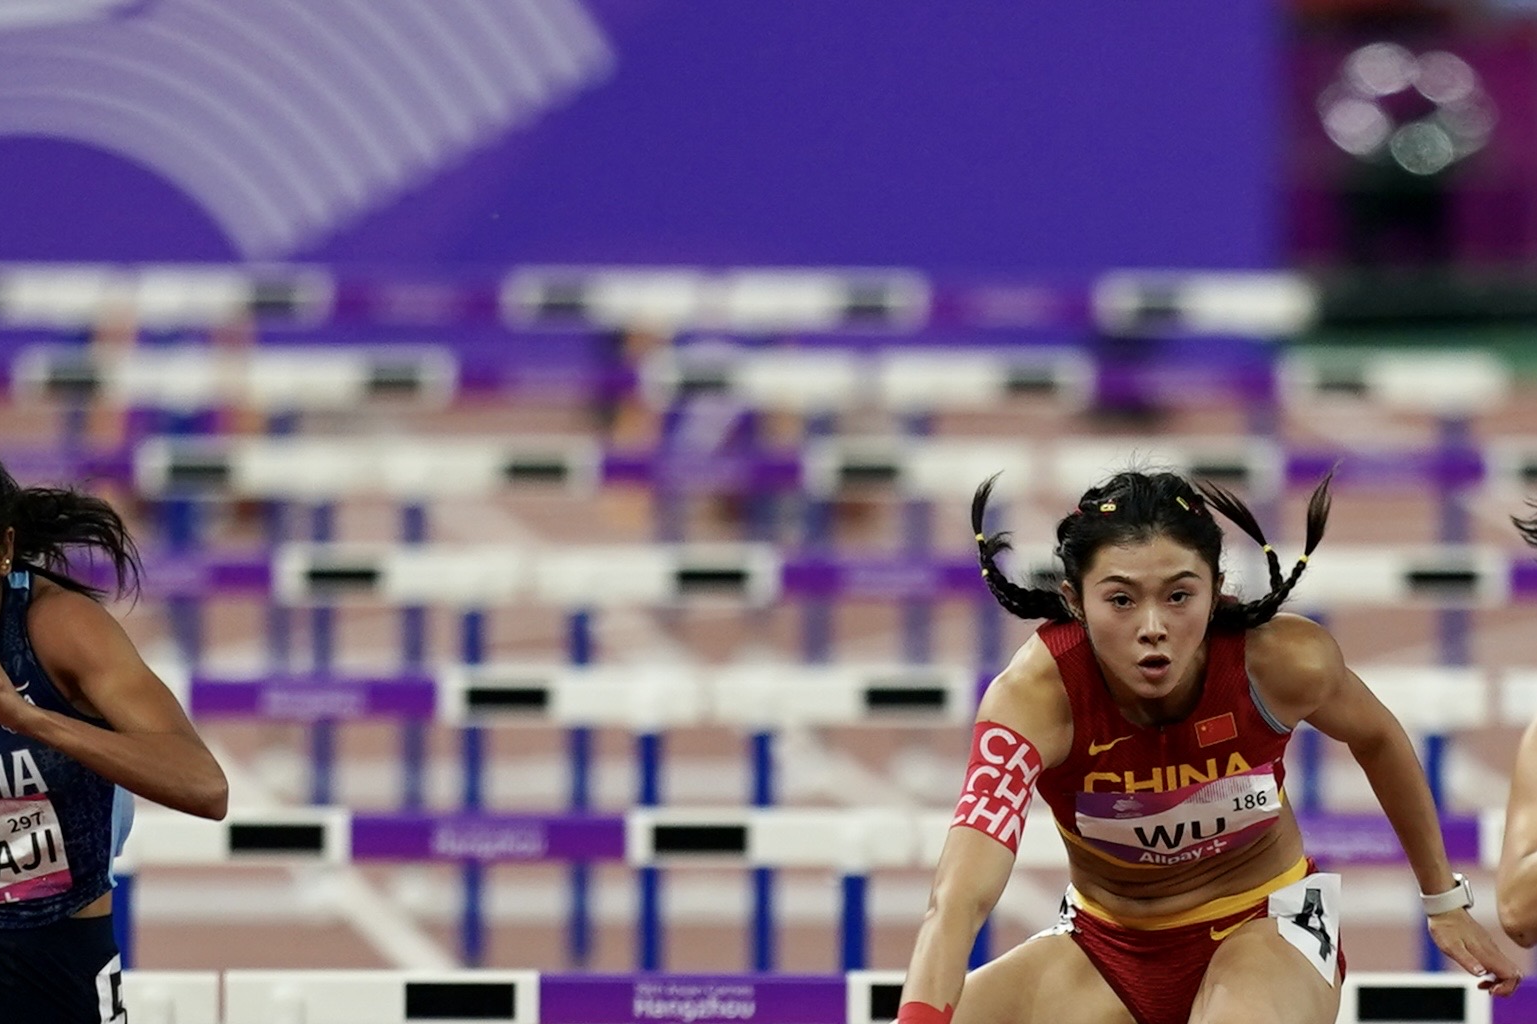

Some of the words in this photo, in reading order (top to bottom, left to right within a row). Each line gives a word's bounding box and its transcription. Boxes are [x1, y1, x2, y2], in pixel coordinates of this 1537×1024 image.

[980, 728, 1040, 786] CH
[1084, 752, 1252, 794] CHINA
[1232, 790, 1267, 812] 186
[7, 811, 43, 833] 297
[1134, 817, 1226, 849] WU
